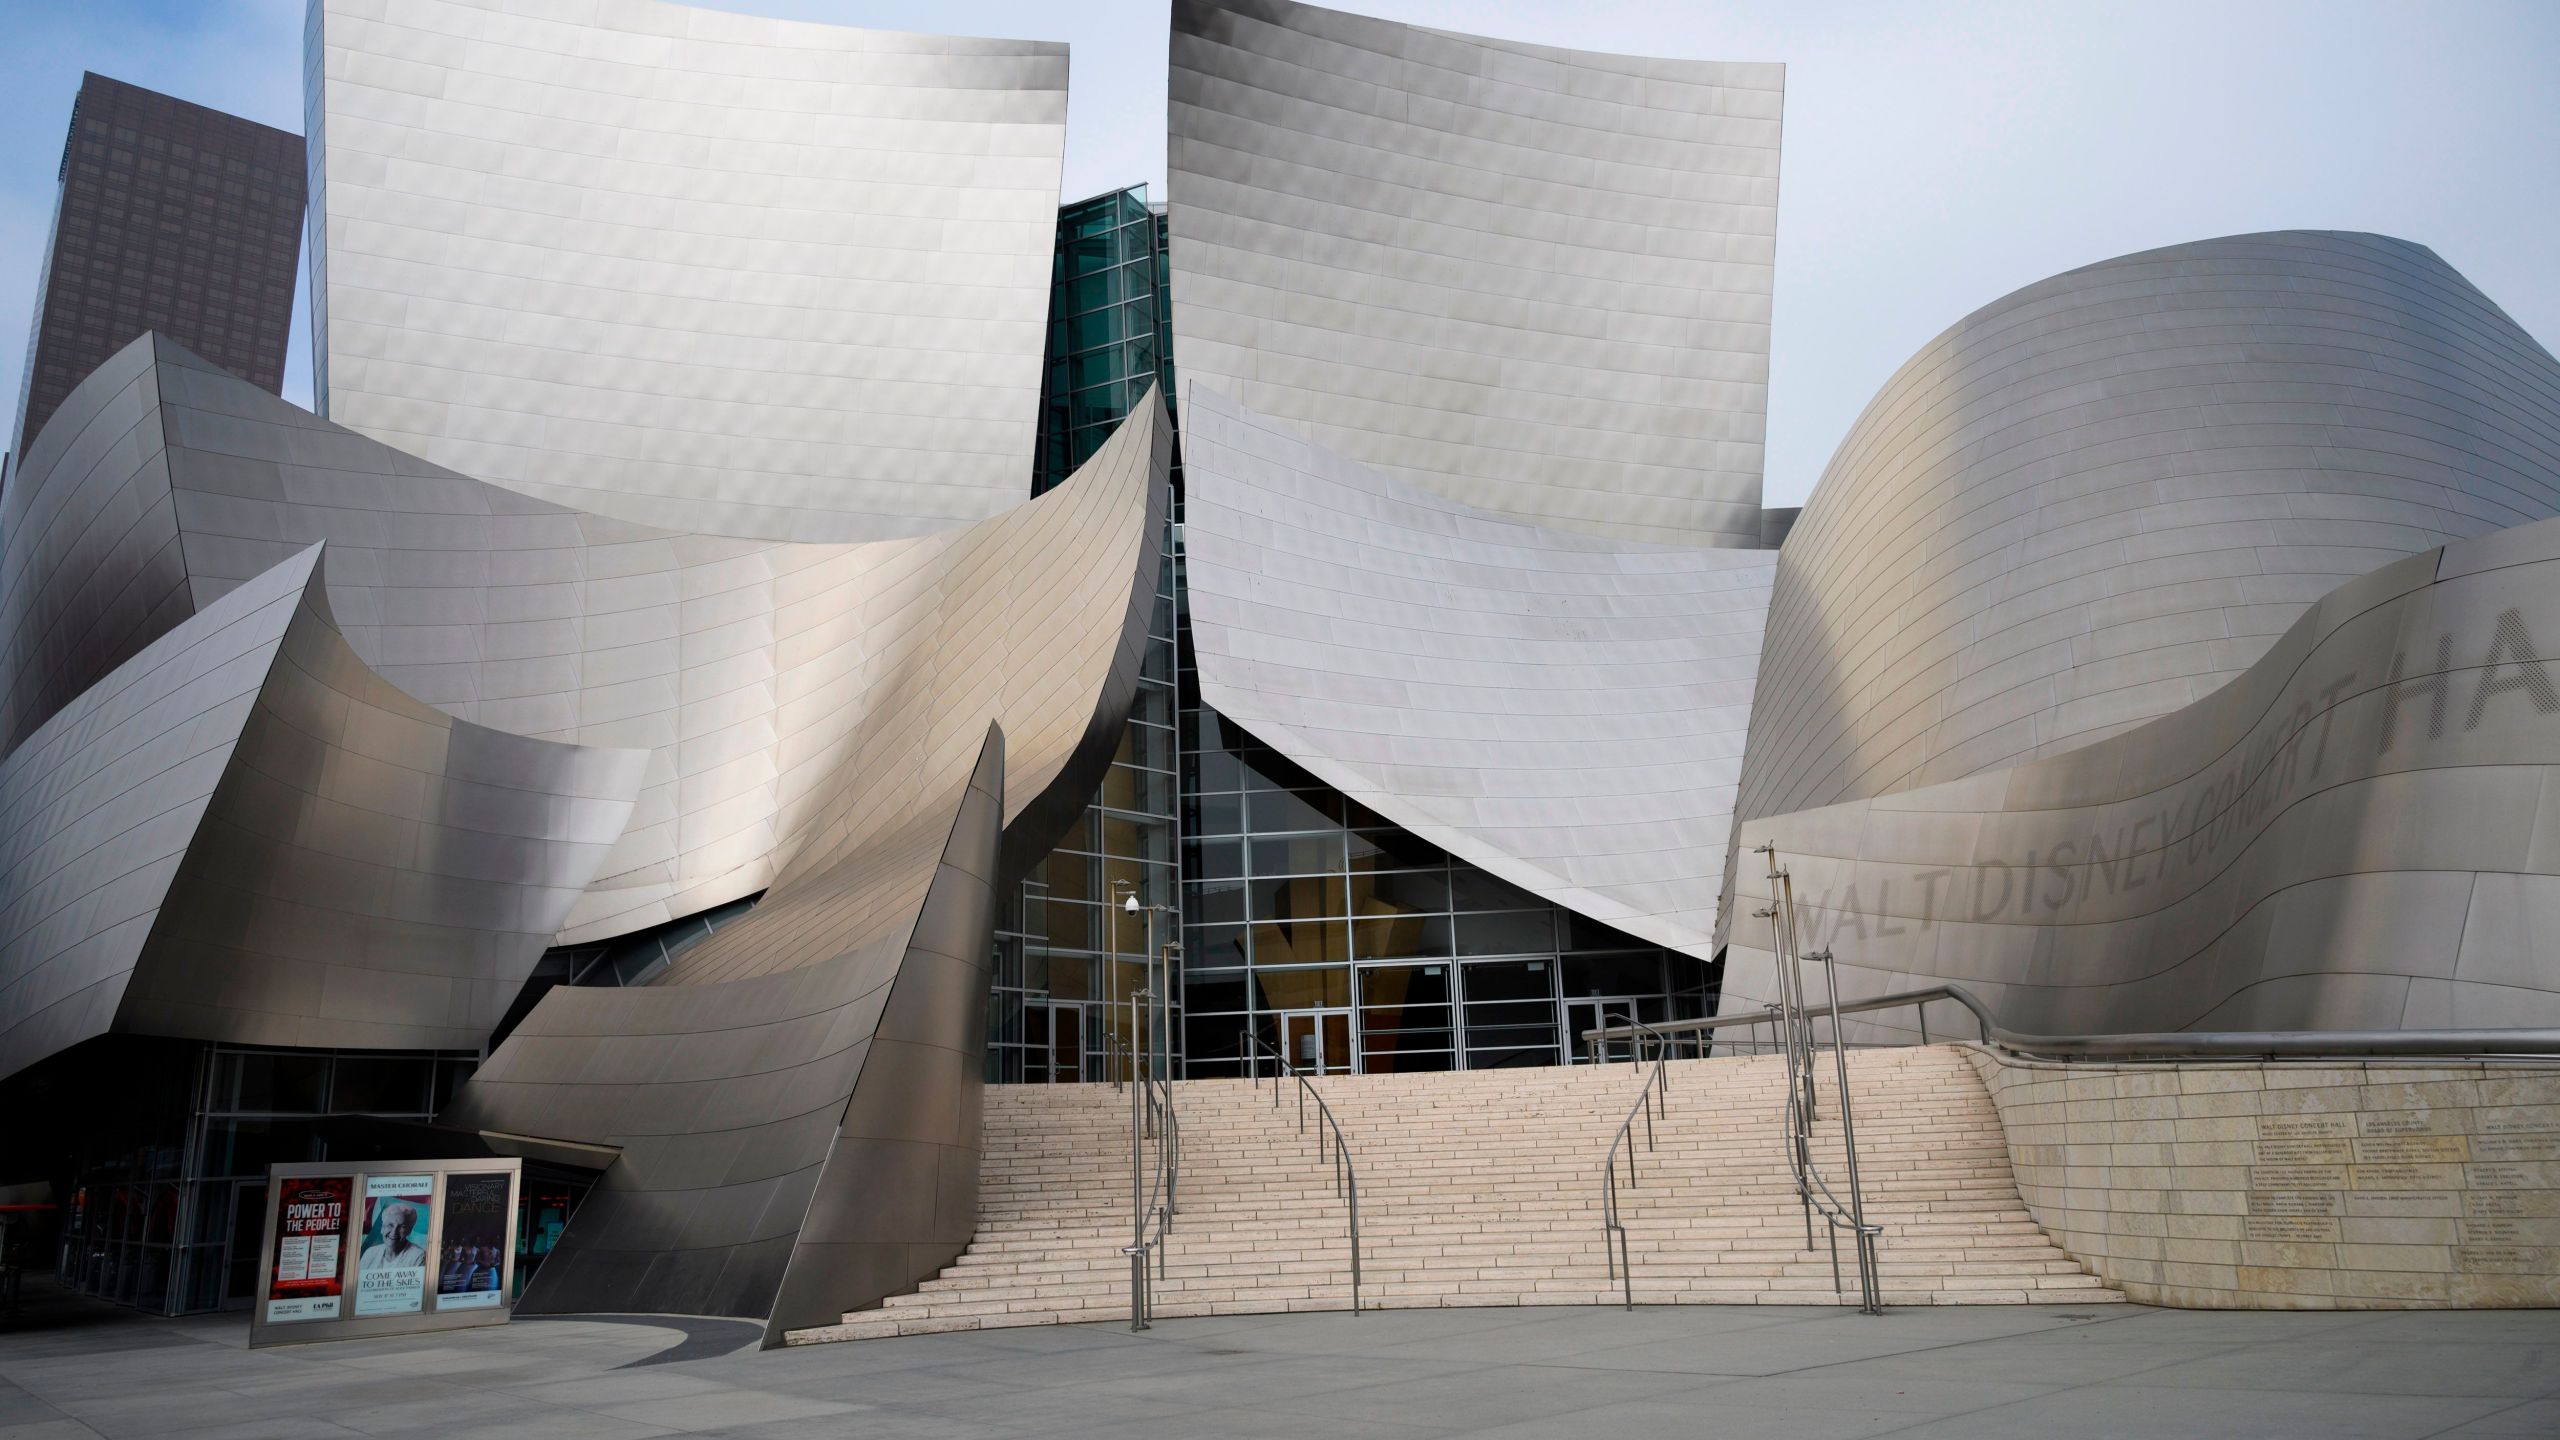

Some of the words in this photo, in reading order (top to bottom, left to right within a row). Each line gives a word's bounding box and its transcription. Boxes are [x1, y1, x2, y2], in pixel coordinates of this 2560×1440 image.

[1777, 866, 1950, 954] WALT
[1970, 800, 2185, 923] DISNEY
[2187, 669, 2359, 867] CONCERT
[2376, 606, 2560, 757] HA
[287, 1203, 325, 1219] POWER
[328, 1202, 341, 1217] TO
[286, 1219, 303, 1232] THE
[305, 1218, 340, 1231] PEOPLE!
[366, 1271, 392, 1280] COME
[395, 1270, 416, 1278] AWAY
[377, 1280, 392, 1288] THE
